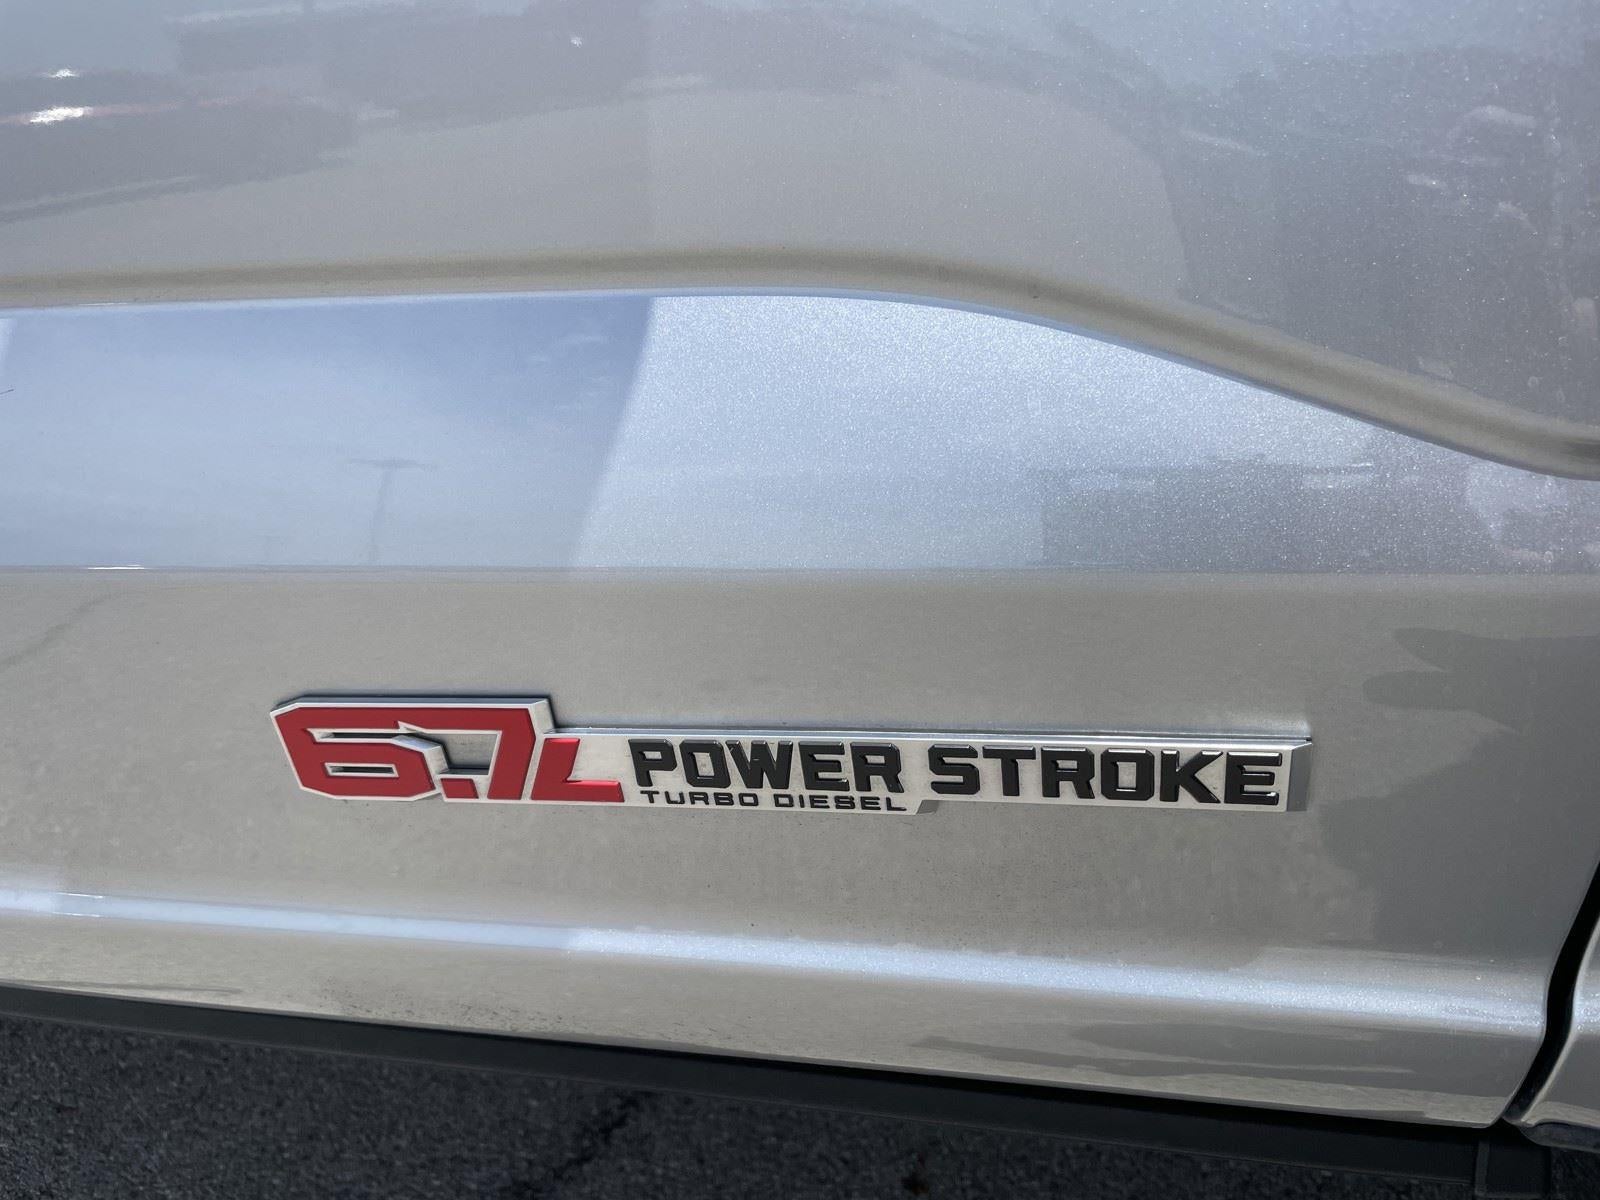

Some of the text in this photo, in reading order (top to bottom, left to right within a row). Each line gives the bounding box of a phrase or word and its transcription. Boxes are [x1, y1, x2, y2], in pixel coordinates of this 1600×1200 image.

[274, 706, 1283, 805] 6.7L POWER STROKE
[640, 790, 907, 812] TURBO DIESEL
